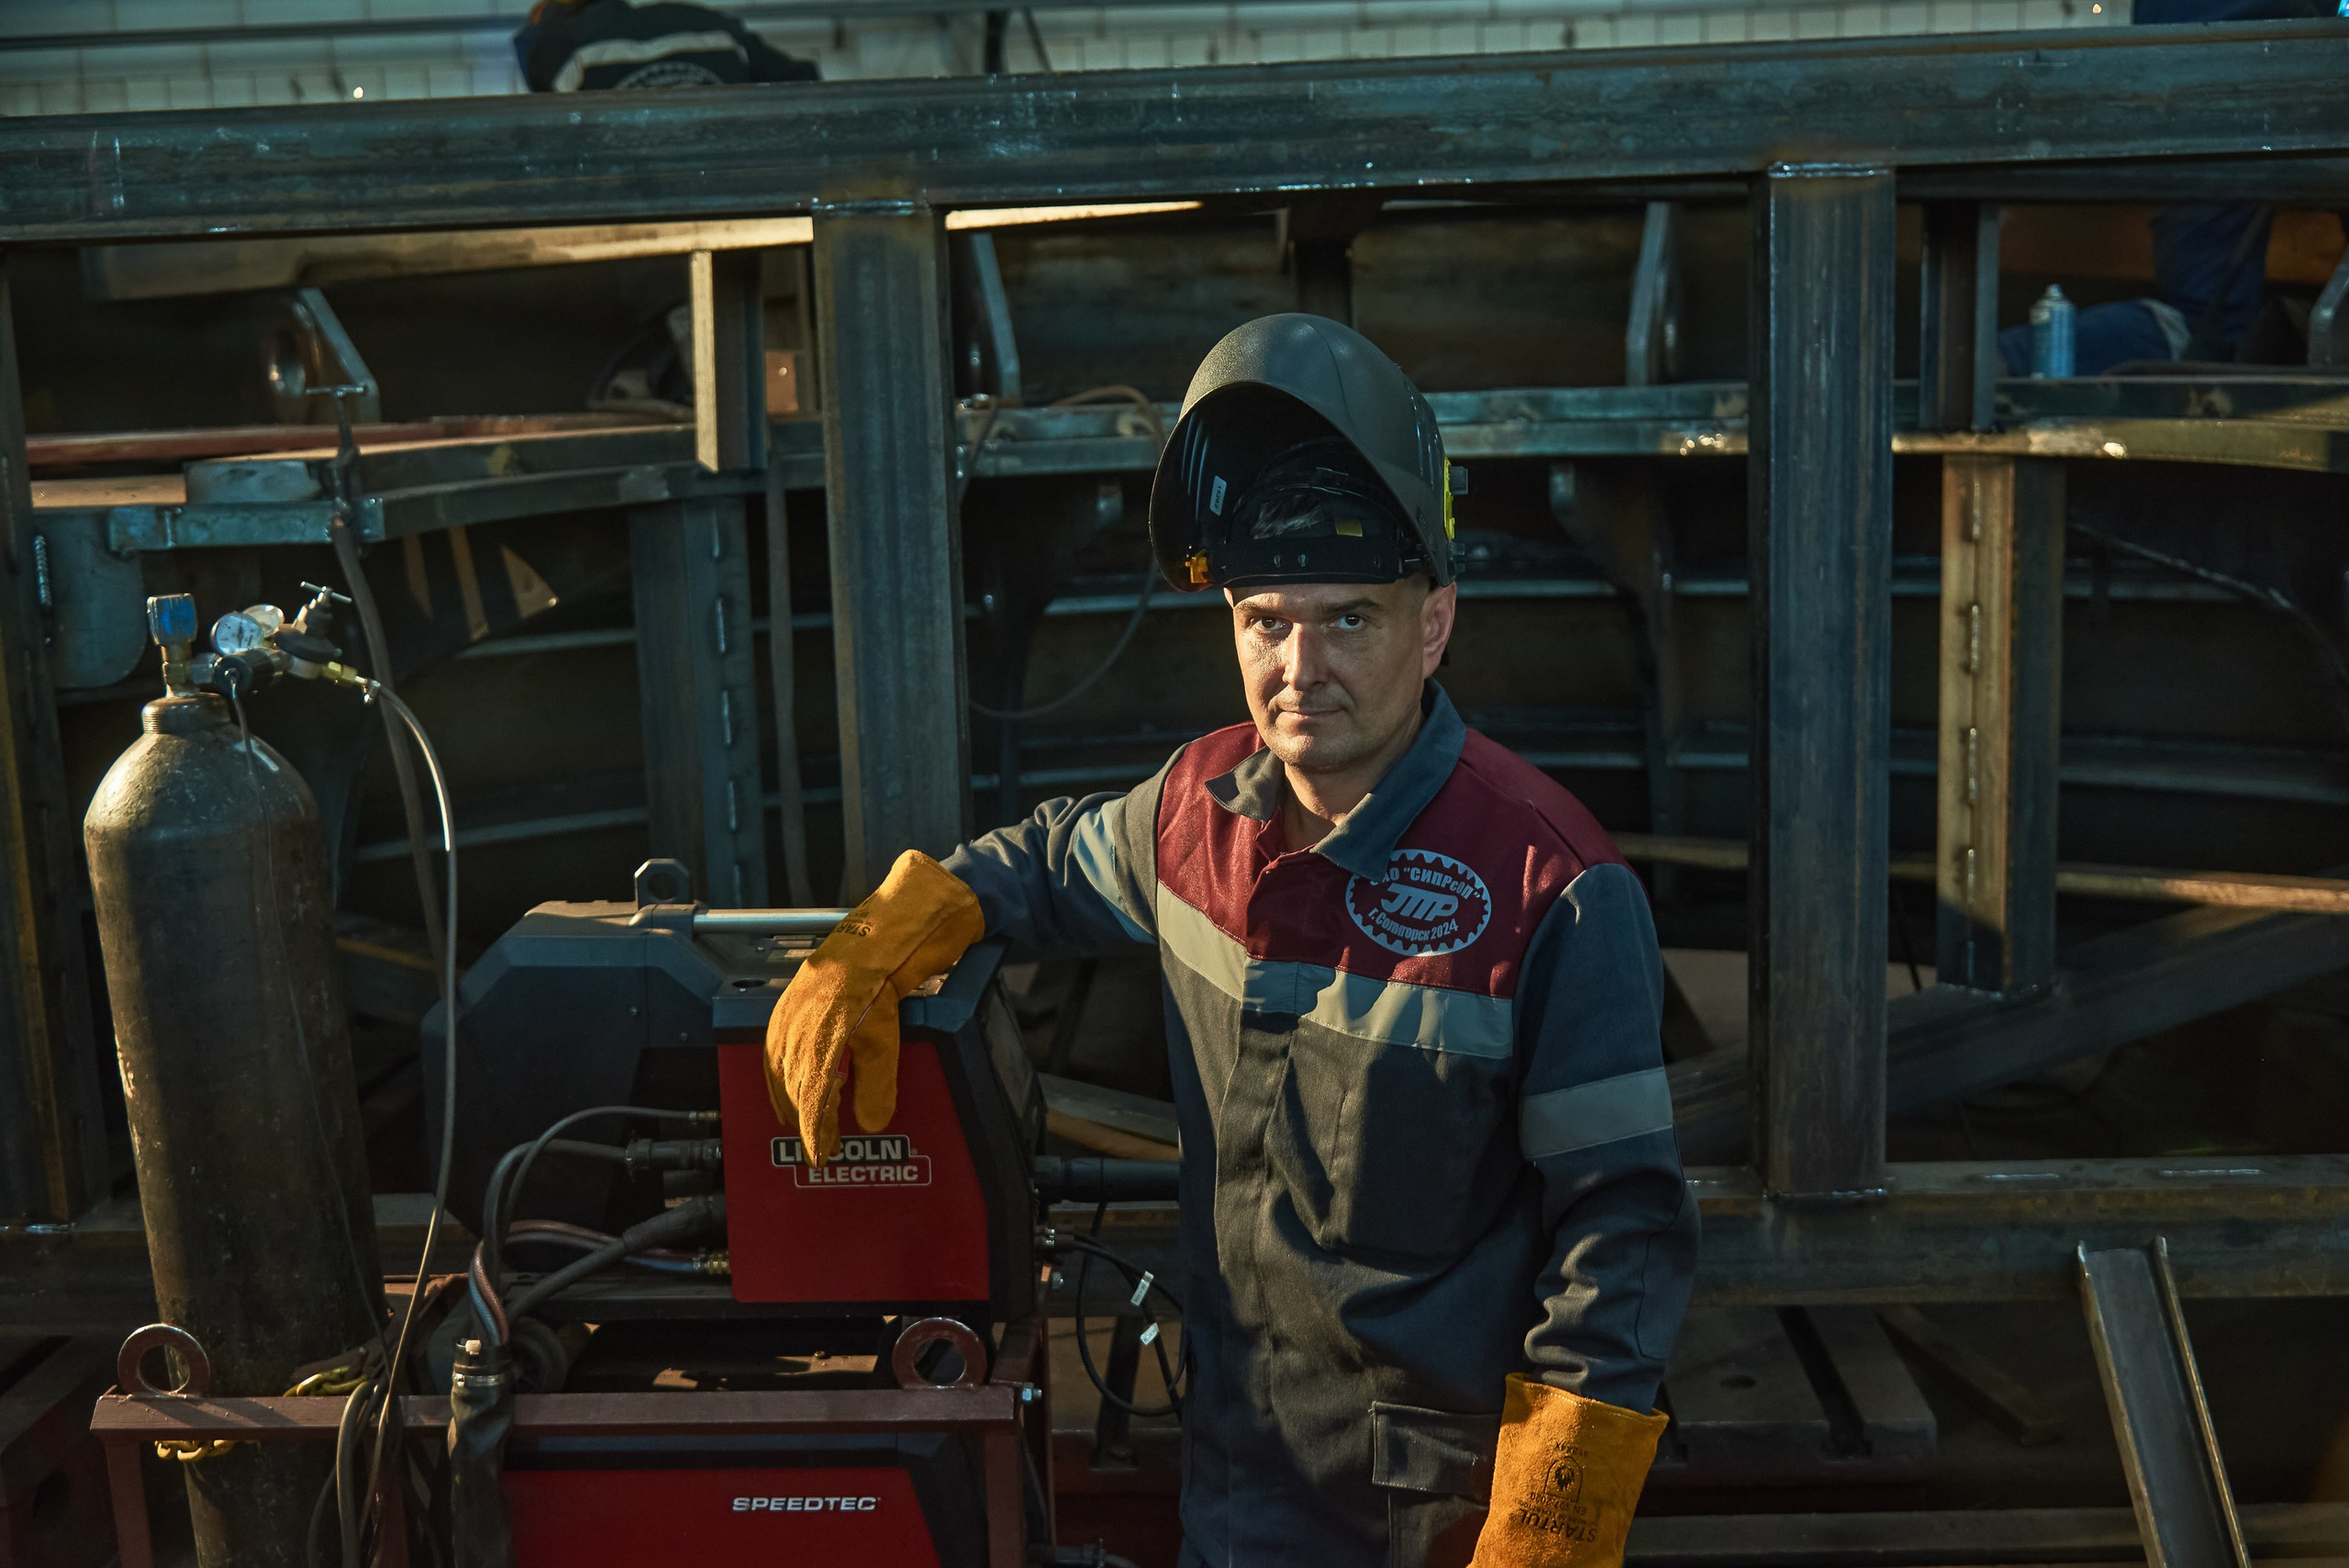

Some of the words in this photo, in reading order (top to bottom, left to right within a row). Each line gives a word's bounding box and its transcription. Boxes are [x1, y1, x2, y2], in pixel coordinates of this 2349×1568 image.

[1370, 867, 1399, 885] АО
[834, 923, 872, 937] STAR
[1431, 918, 1459, 940] 2024
[780, 1140, 902, 1162] LIOLN
[808, 1164, 918, 1184] ELECTRIC
[732, 1496, 876, 1511] SPEEDTEC
[1573, 1506, 1587, 1516] EN
[1519, 1507, 1598, 1542] STARTUL
